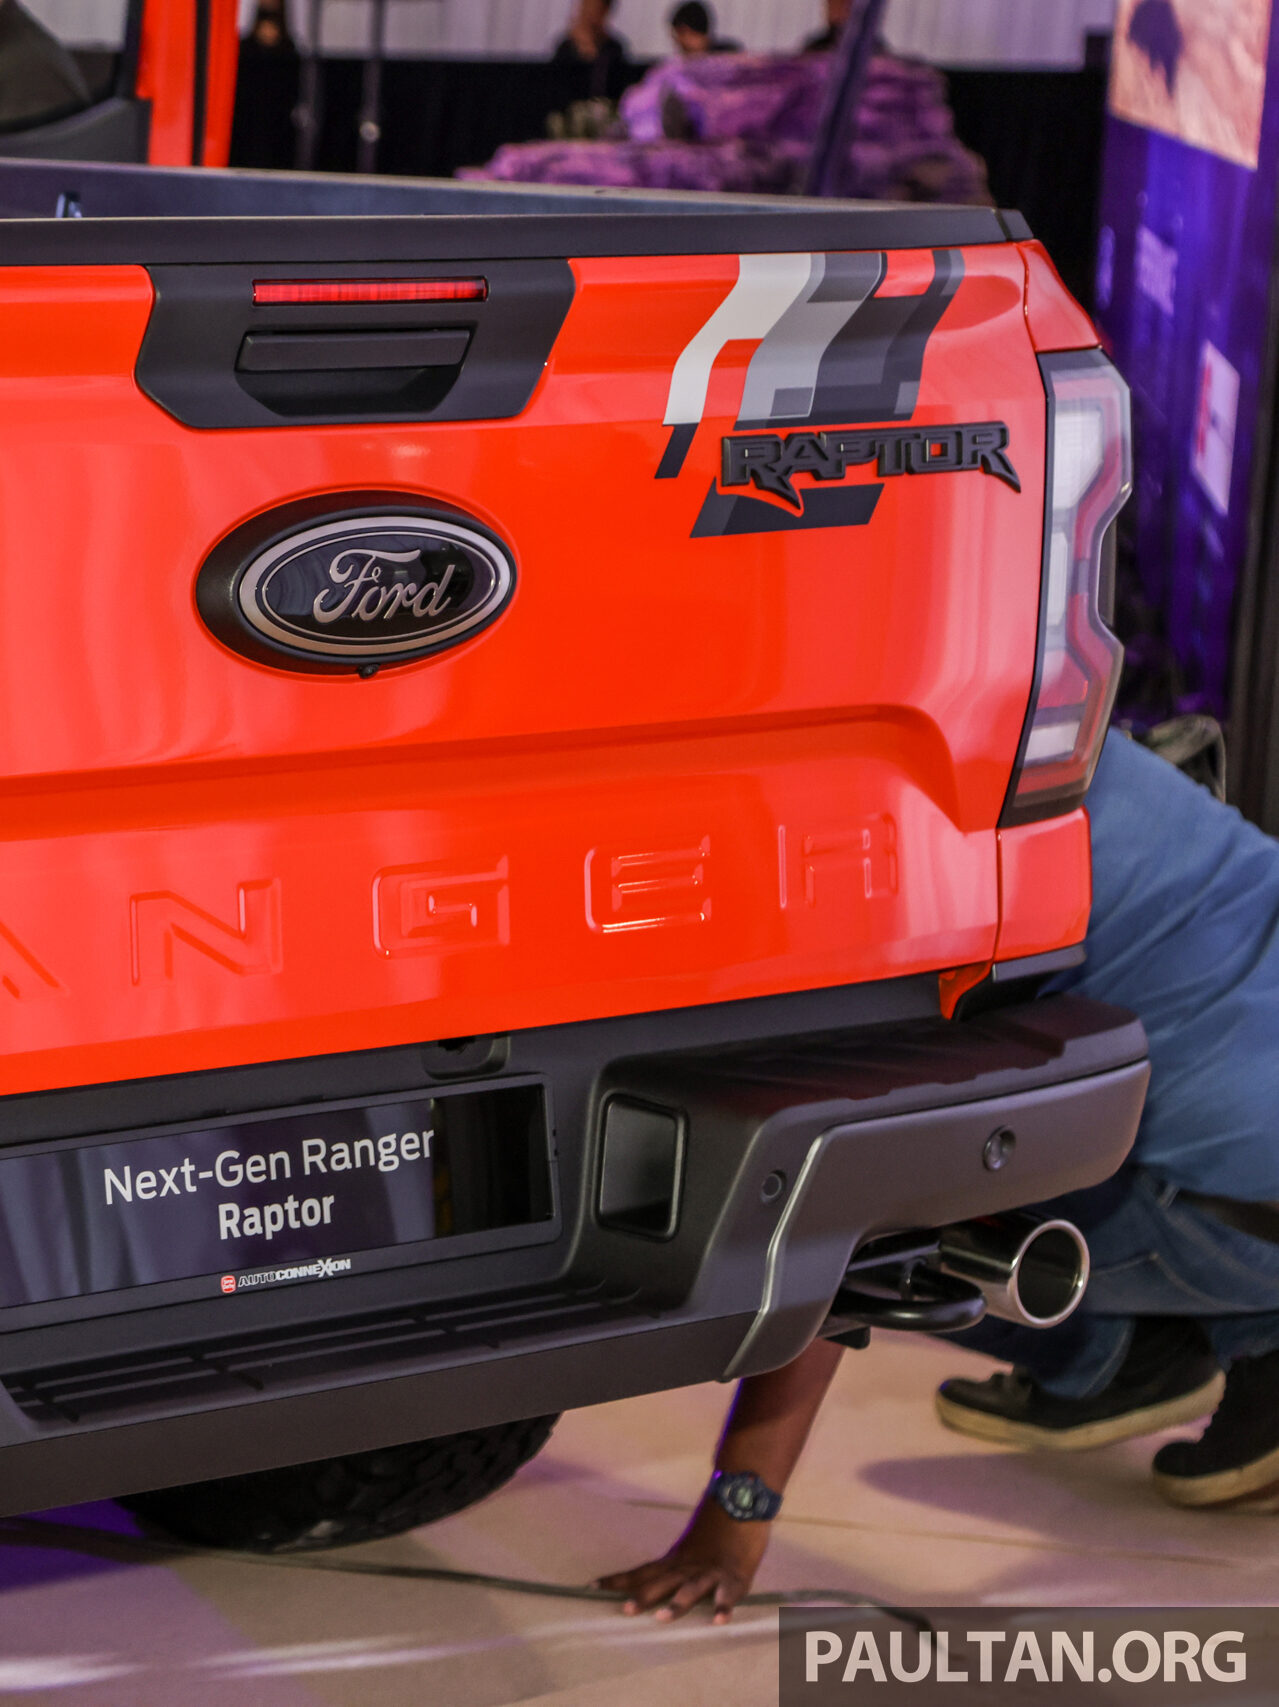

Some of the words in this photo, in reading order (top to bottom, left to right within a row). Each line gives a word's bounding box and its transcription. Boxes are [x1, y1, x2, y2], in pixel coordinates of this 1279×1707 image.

[721, 421, 1021, 510] RAPTOR
[313, 549, 451, 623] Ford
[104, 1150, 291, 1205] Next-Gen
[302, 1129, 434, 1173] Ranger
[218, 1194, 334, 1240] Raptor
